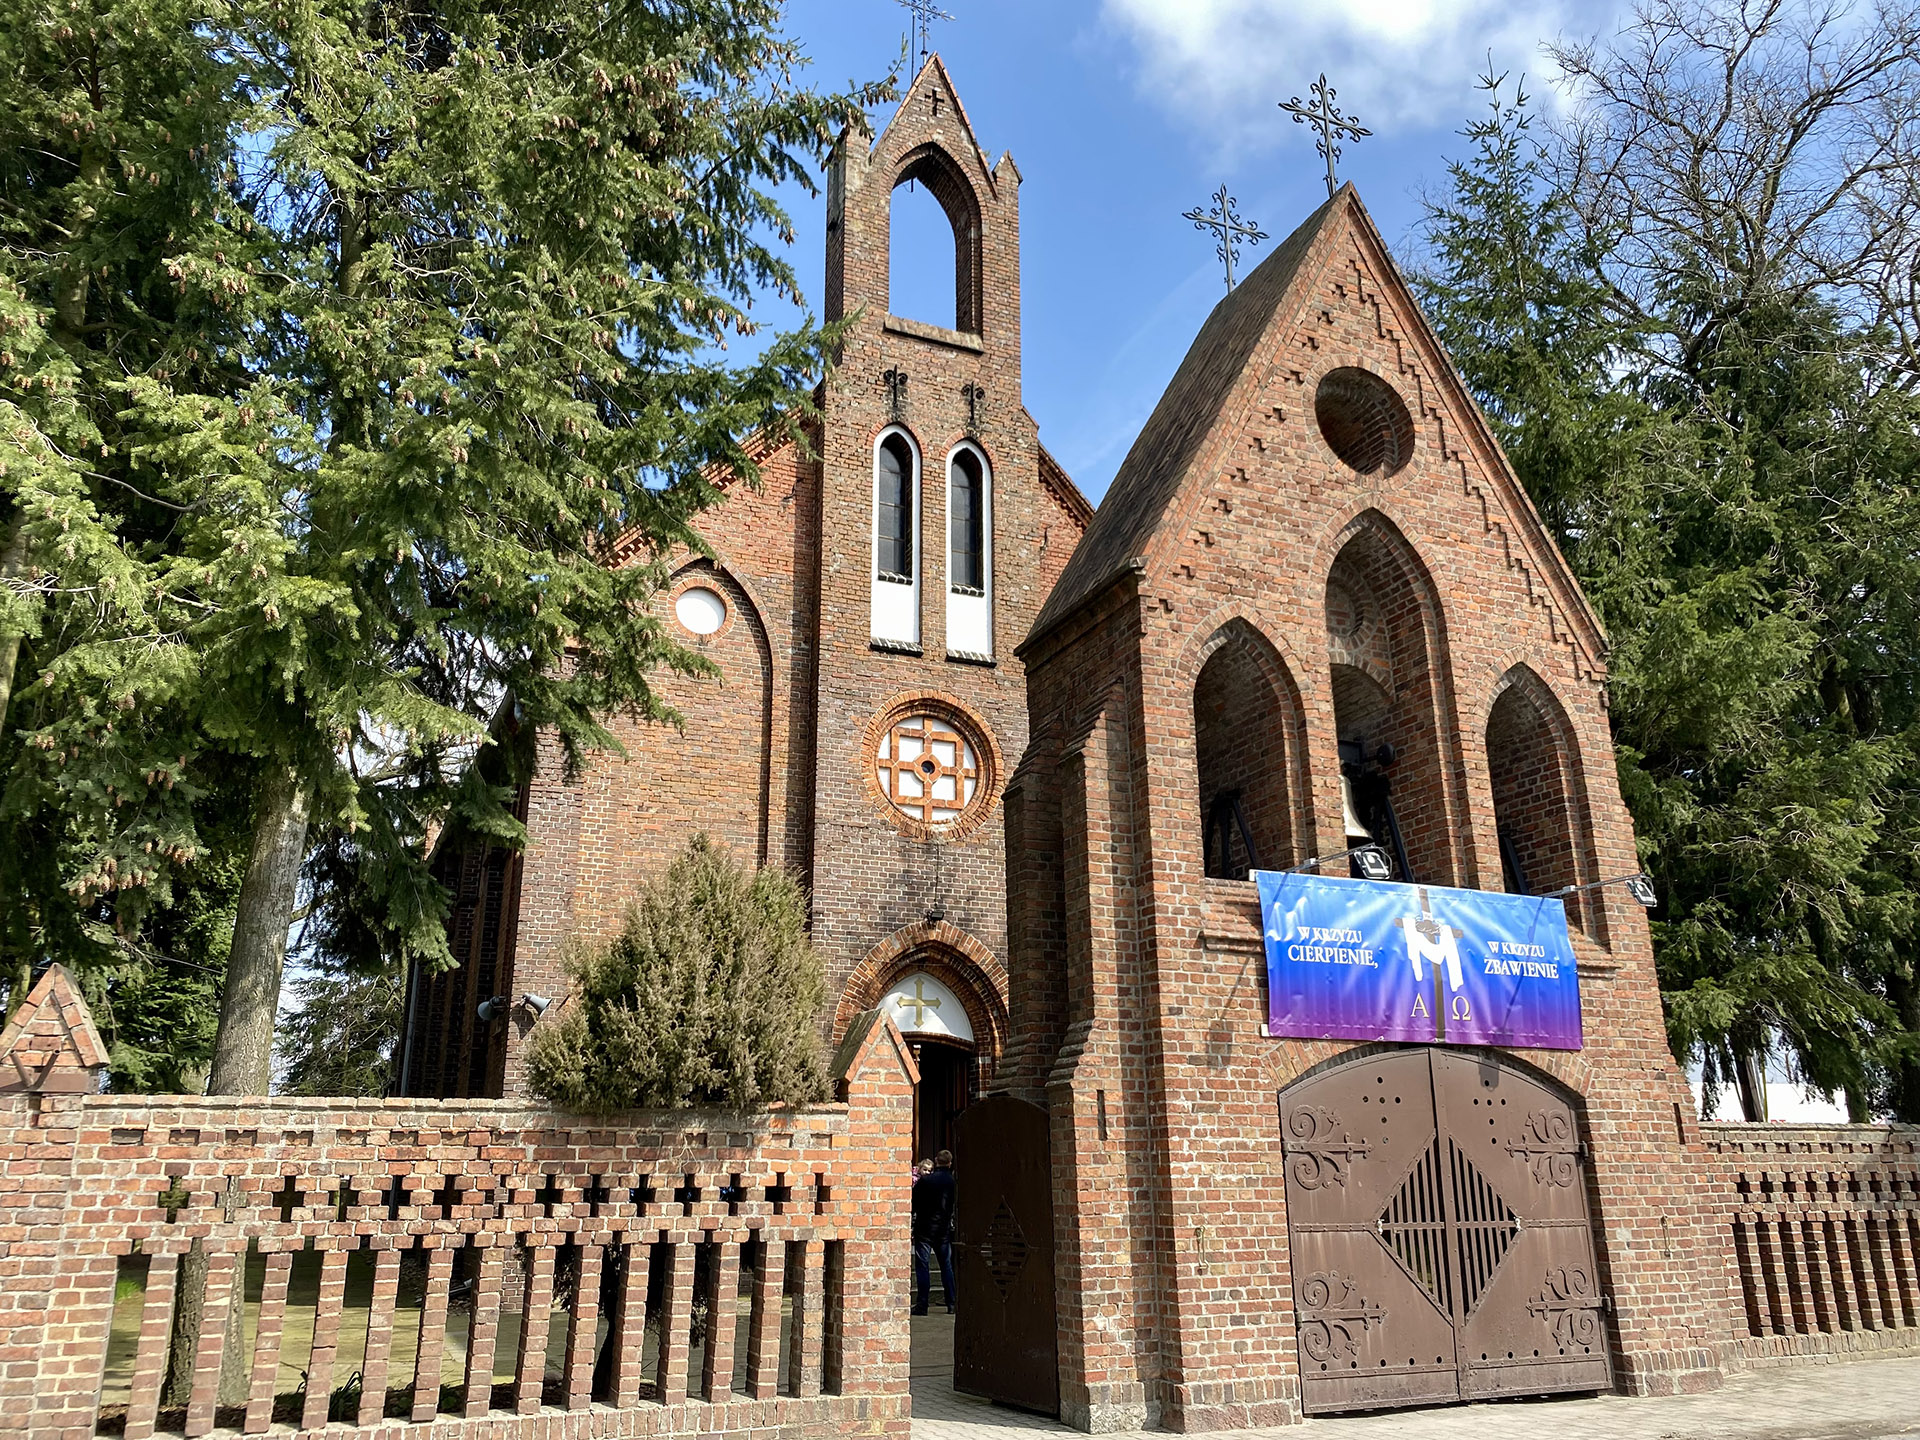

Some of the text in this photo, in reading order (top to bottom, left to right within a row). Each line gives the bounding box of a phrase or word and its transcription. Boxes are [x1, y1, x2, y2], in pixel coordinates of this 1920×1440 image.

[1296, 926, 1362, 944] W KRZYŻU
[1287, 944, 1378, 969] CIERPIENIE,
[1487, 941, 1545, 958] W KRZYŻU
[1484, 958, 1559, 979] ZBAWIENIE
[1452, 995, 1471, 1021] Ω
